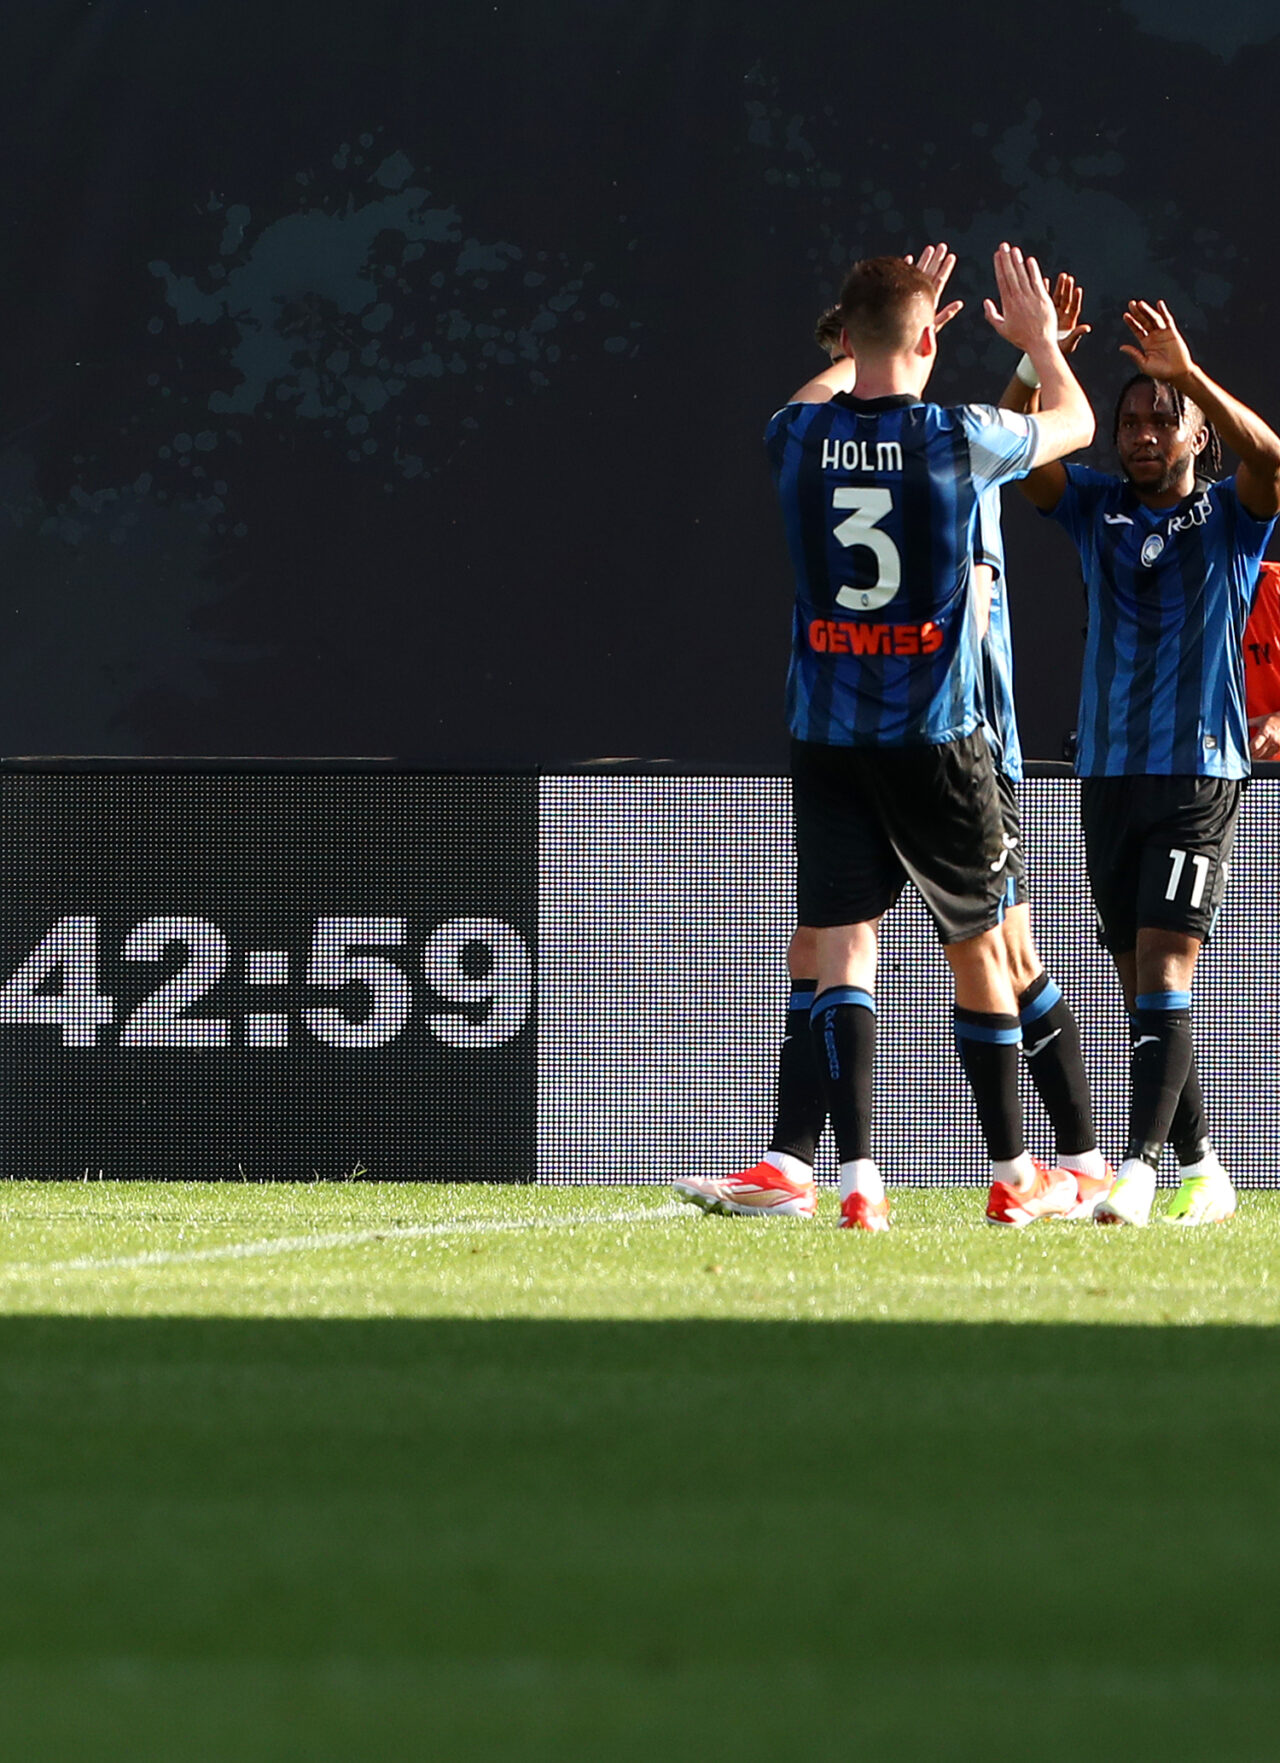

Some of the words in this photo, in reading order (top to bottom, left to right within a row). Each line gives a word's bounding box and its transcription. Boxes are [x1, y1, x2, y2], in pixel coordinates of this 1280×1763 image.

[821, 438, 903, 471] HOLM
[832, 486, 900, 611] 3
[1165, 848, 1210, 908] 11
[0, 915, 533, 1048] 42:59
